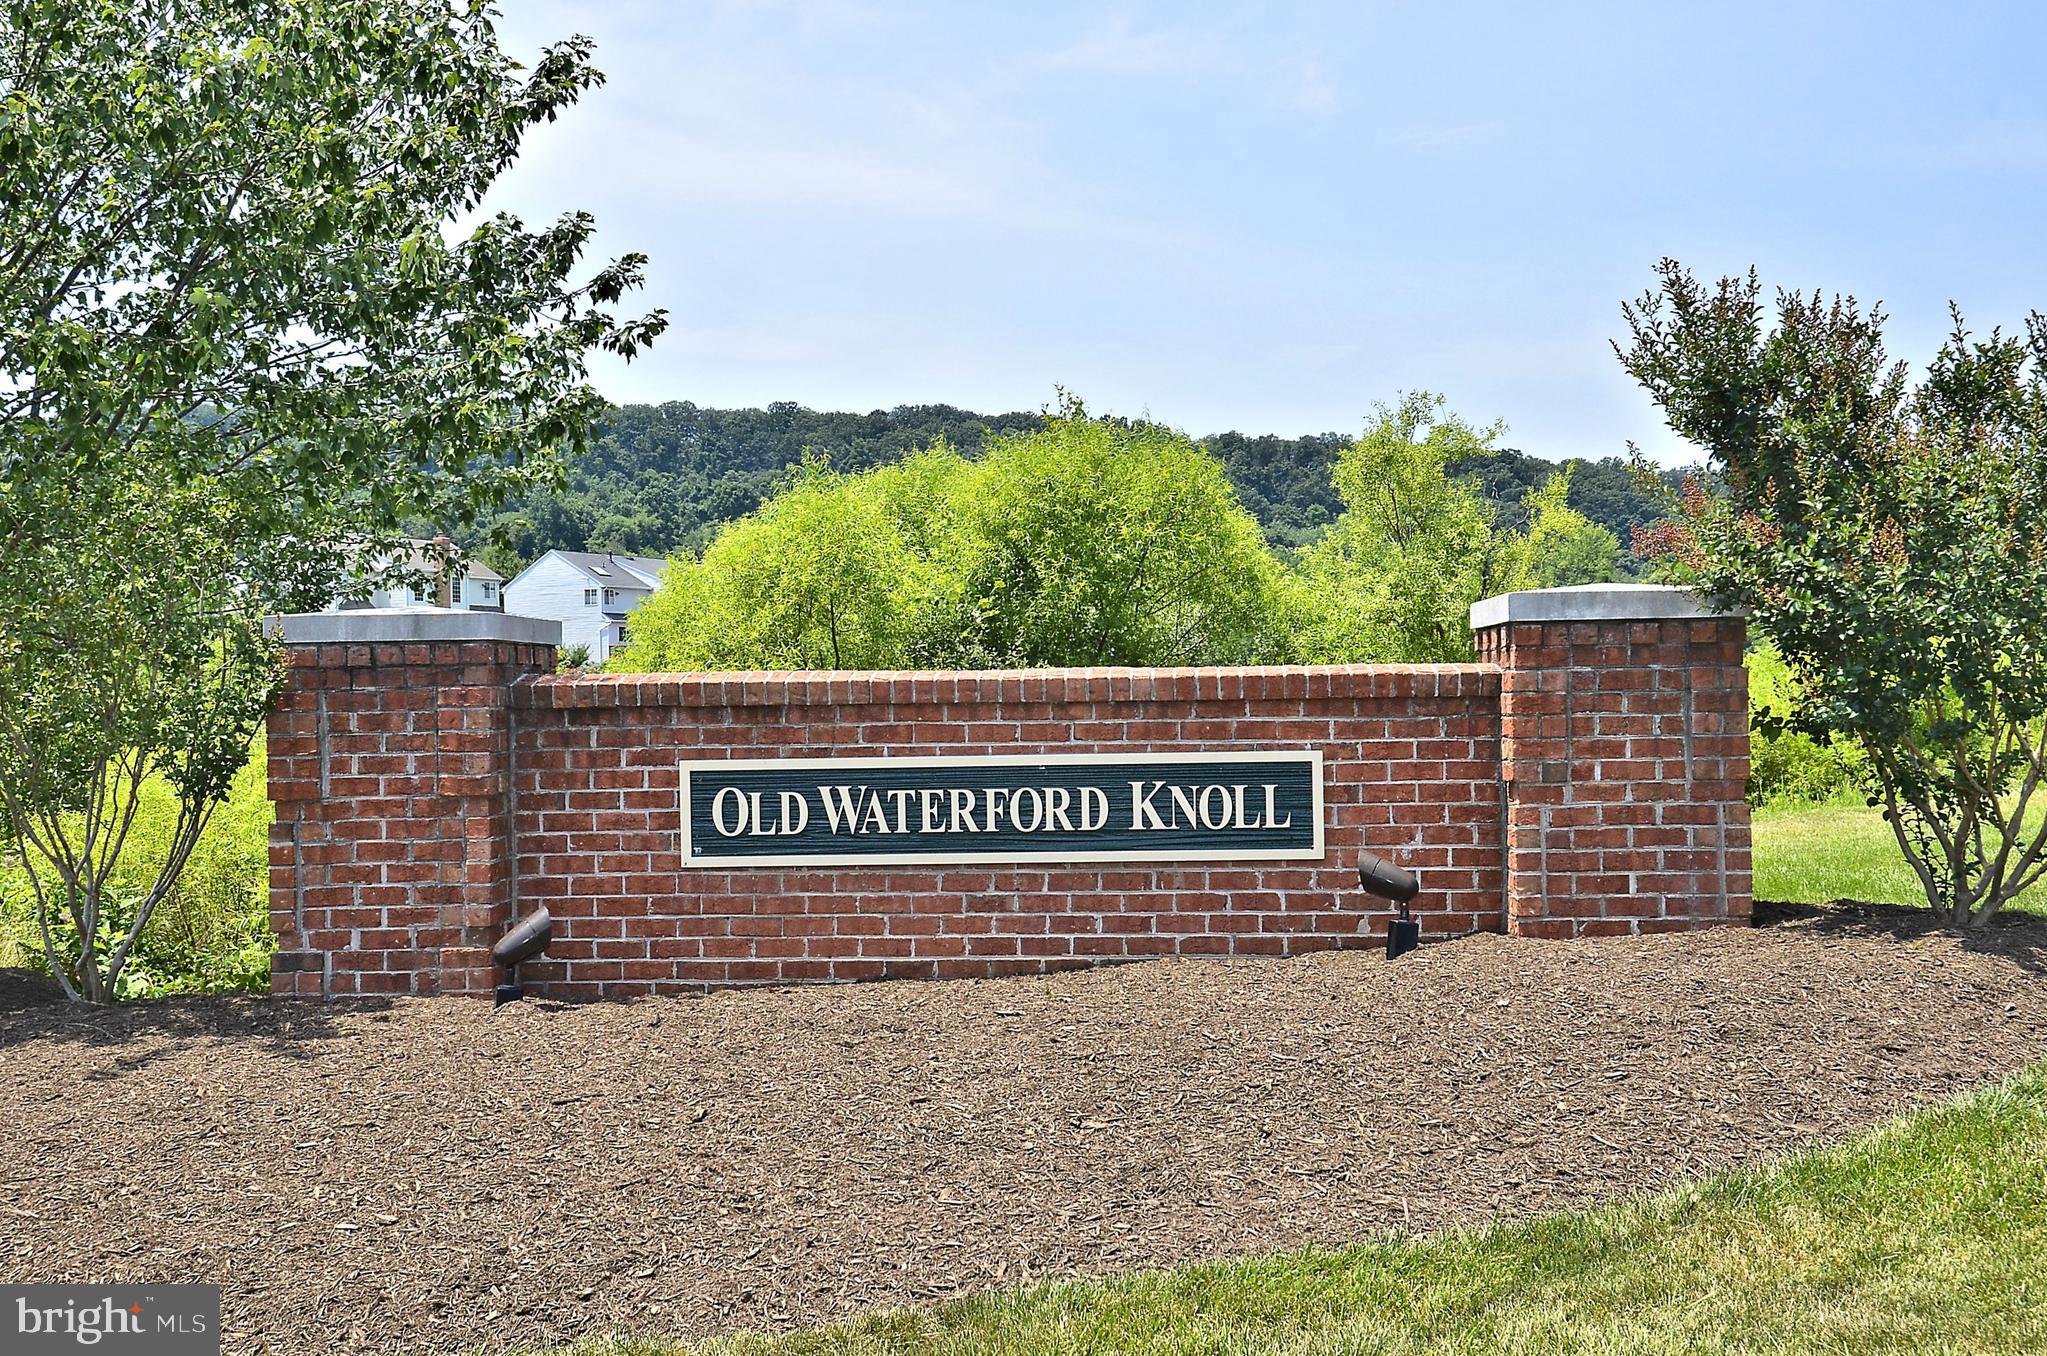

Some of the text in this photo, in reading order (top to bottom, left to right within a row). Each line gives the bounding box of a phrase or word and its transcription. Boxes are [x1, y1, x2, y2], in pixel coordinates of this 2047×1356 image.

[711, 780, 1292, 837] OLD WATERFORD KNOLL
